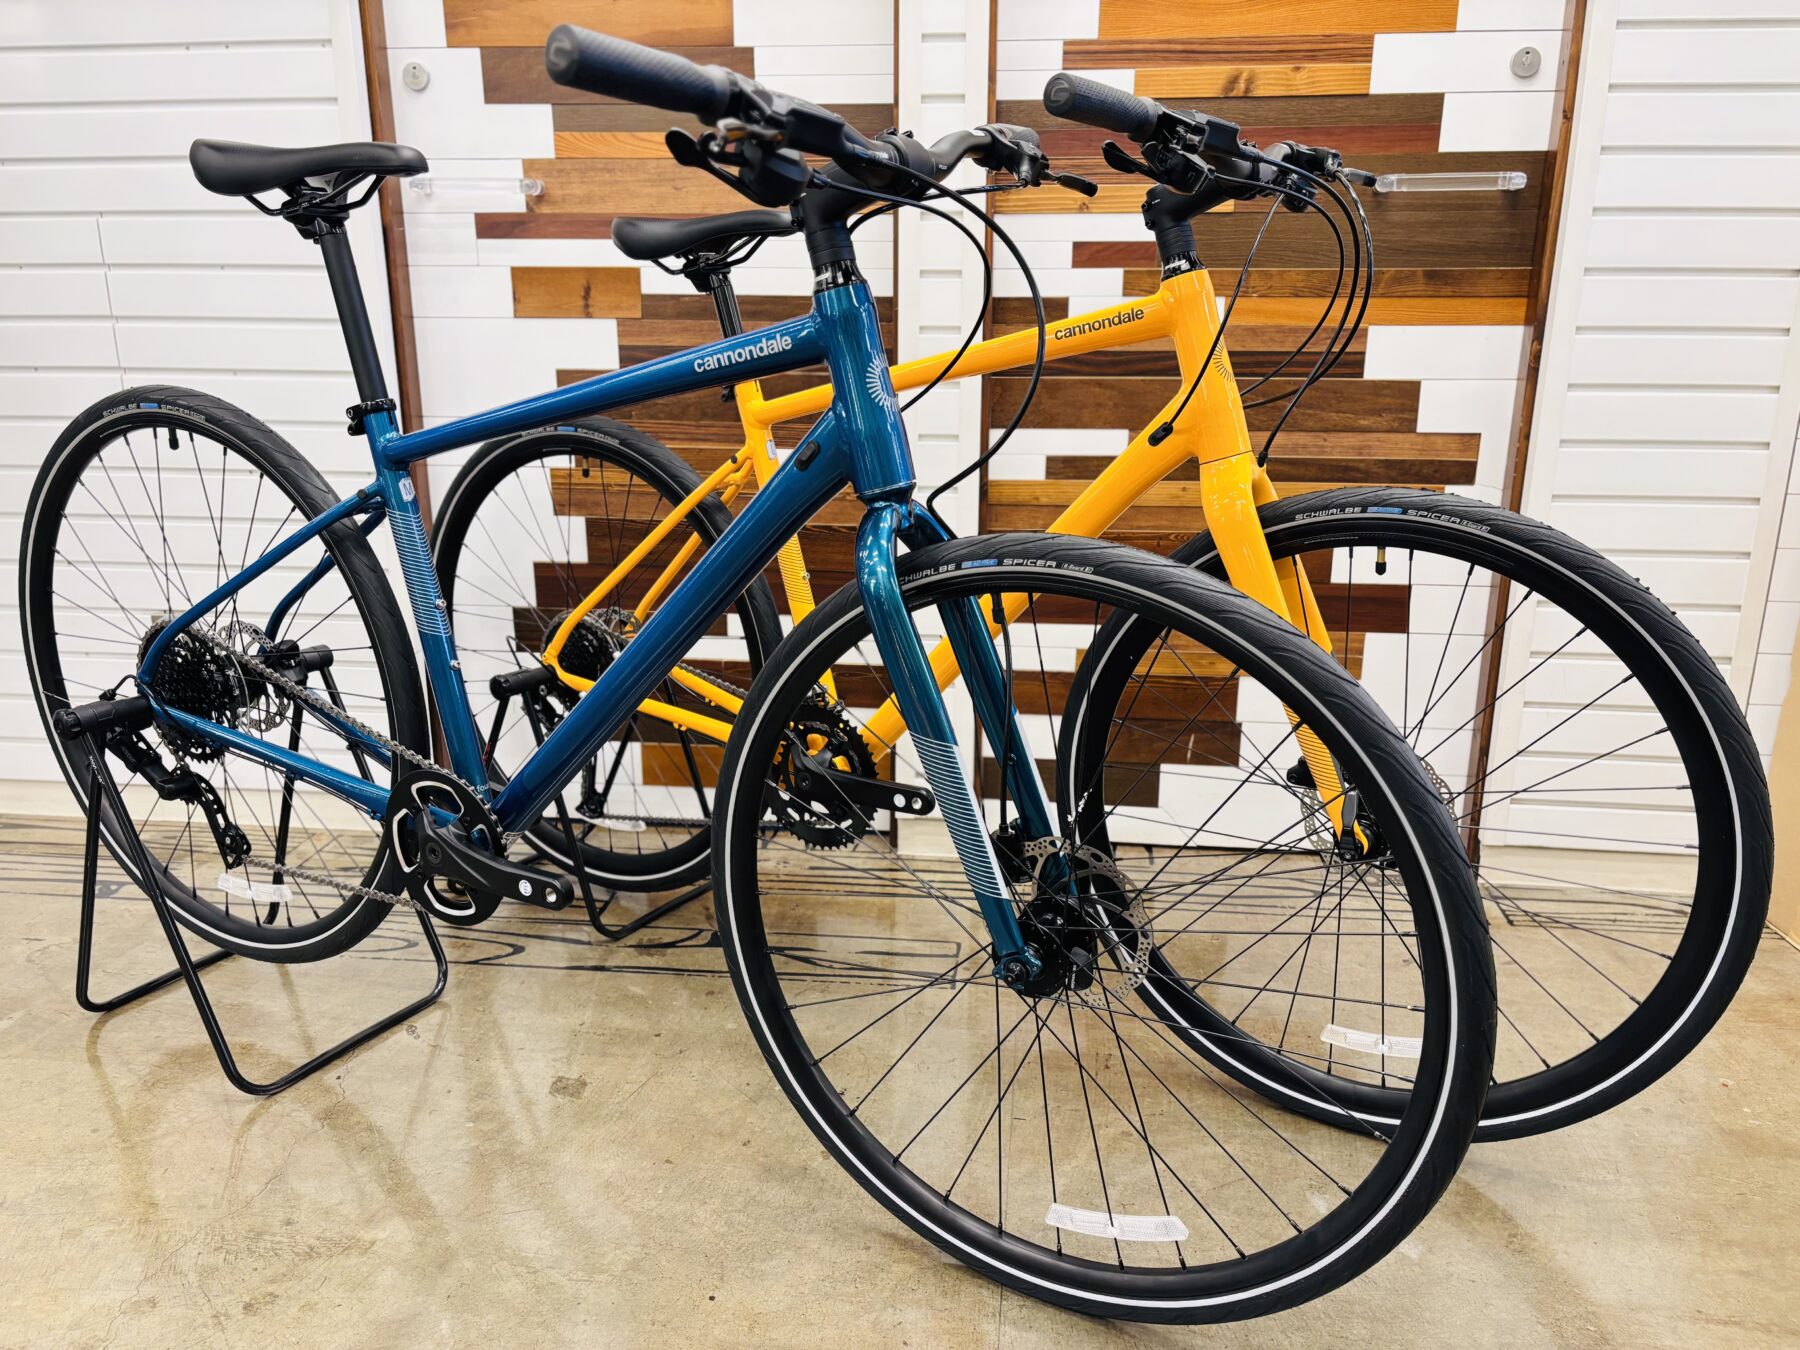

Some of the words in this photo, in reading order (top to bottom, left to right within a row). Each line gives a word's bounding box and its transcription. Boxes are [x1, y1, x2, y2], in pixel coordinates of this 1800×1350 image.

[1054, 307, 1145, 341] cannondale
[693, 333, 793, 373] cannondale
[402, 481, 414, 497] M
[1294, 506, 1363, 521] SCHWALBE
[1406, 509, 1460, 524] SPICER
[899, 563, 956, 585] CHWALBE
[1002, 558, 1057, 568] SPICER
